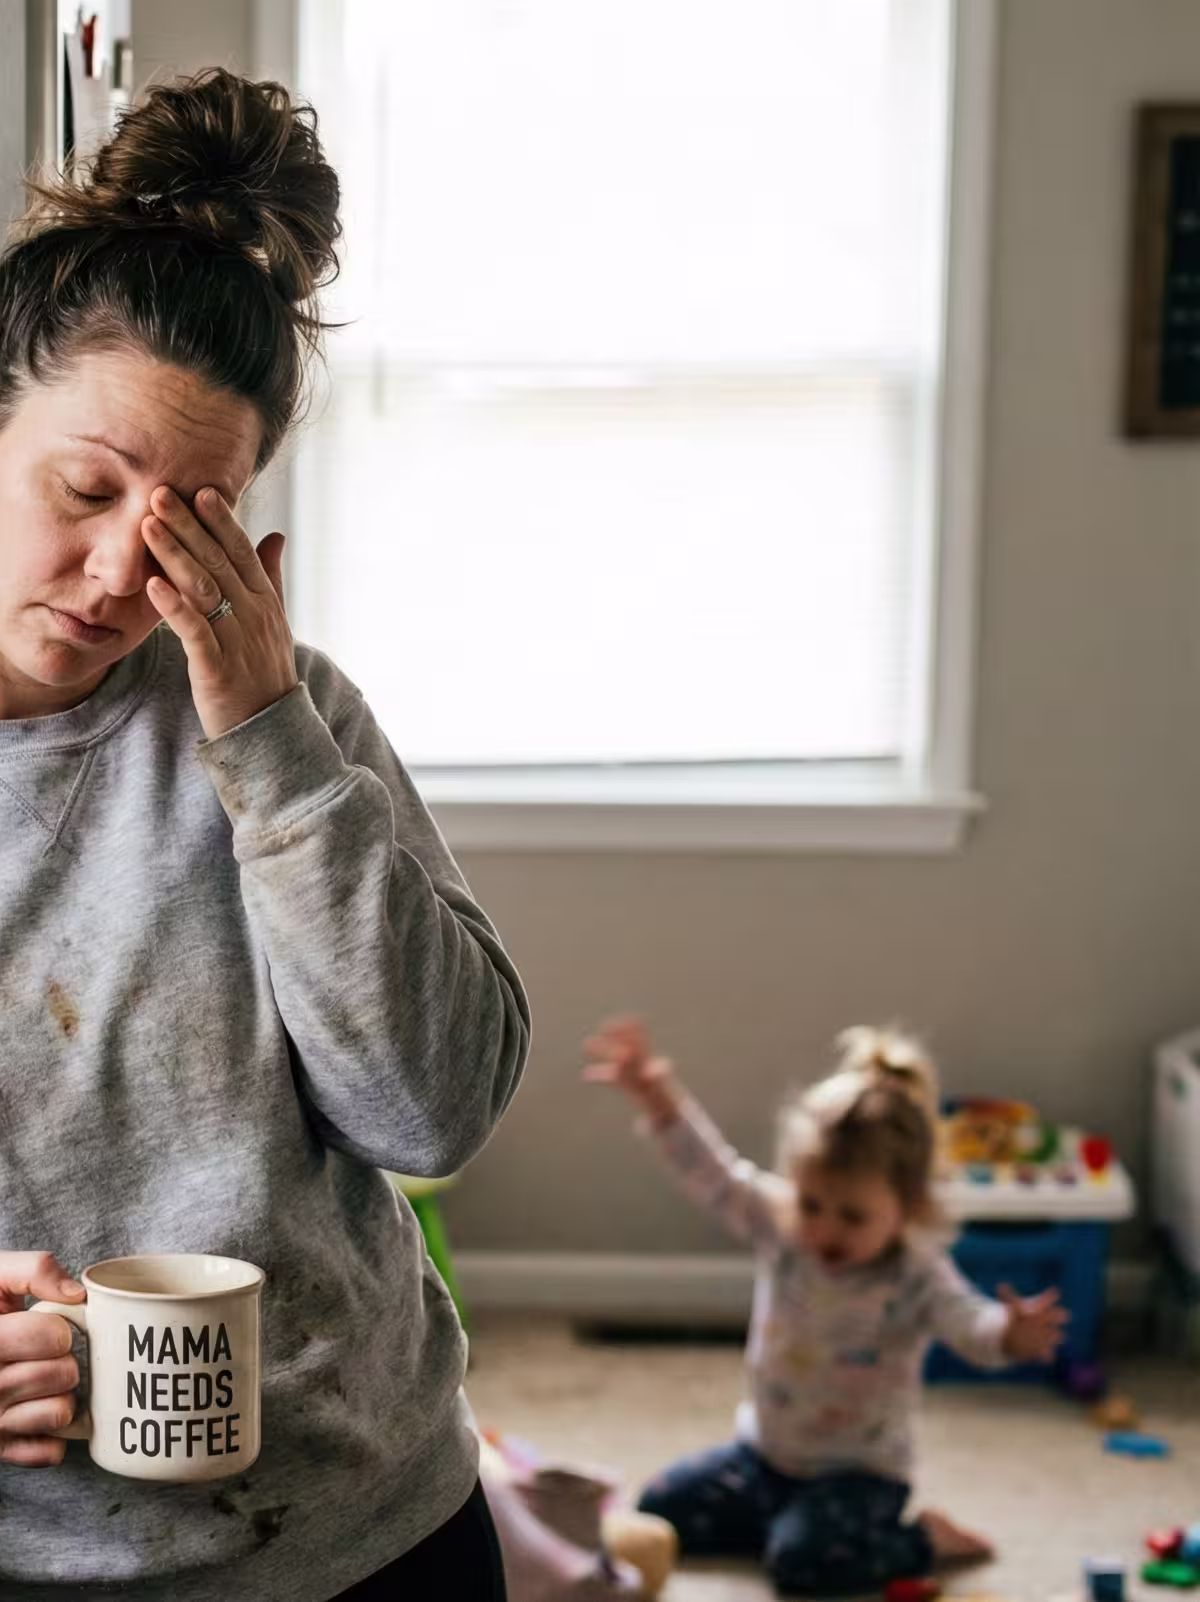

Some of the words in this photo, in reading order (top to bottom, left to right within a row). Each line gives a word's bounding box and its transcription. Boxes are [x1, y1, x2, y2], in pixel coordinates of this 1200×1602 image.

[128, 1323, 232, 1365] MAMA
[127, 1370, 233, 1411] NEEDS
[119, 1413, 240, 1458] COFFEE
